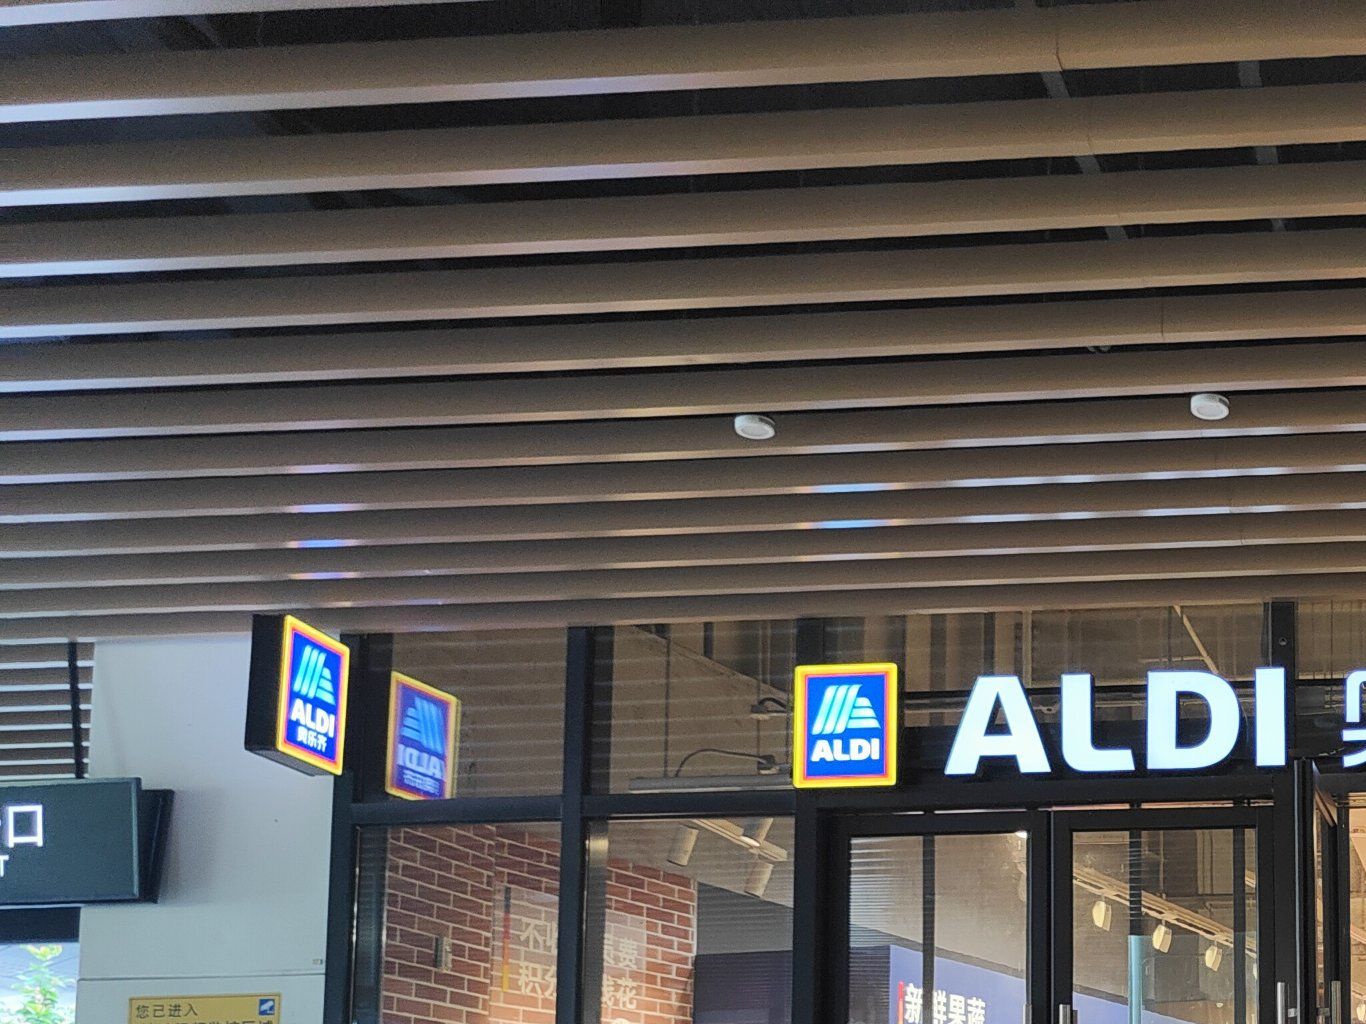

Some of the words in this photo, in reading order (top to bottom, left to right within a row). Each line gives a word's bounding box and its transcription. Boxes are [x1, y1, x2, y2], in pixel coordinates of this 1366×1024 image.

[291, 697, 335, 738] ALDI
[945, 667, 1286, 775] ALDI
[811, 738, 880, 762] ALDI
[0, 804, 43, 848] 口
[136, 1003, 198, 1019] 您已进入
